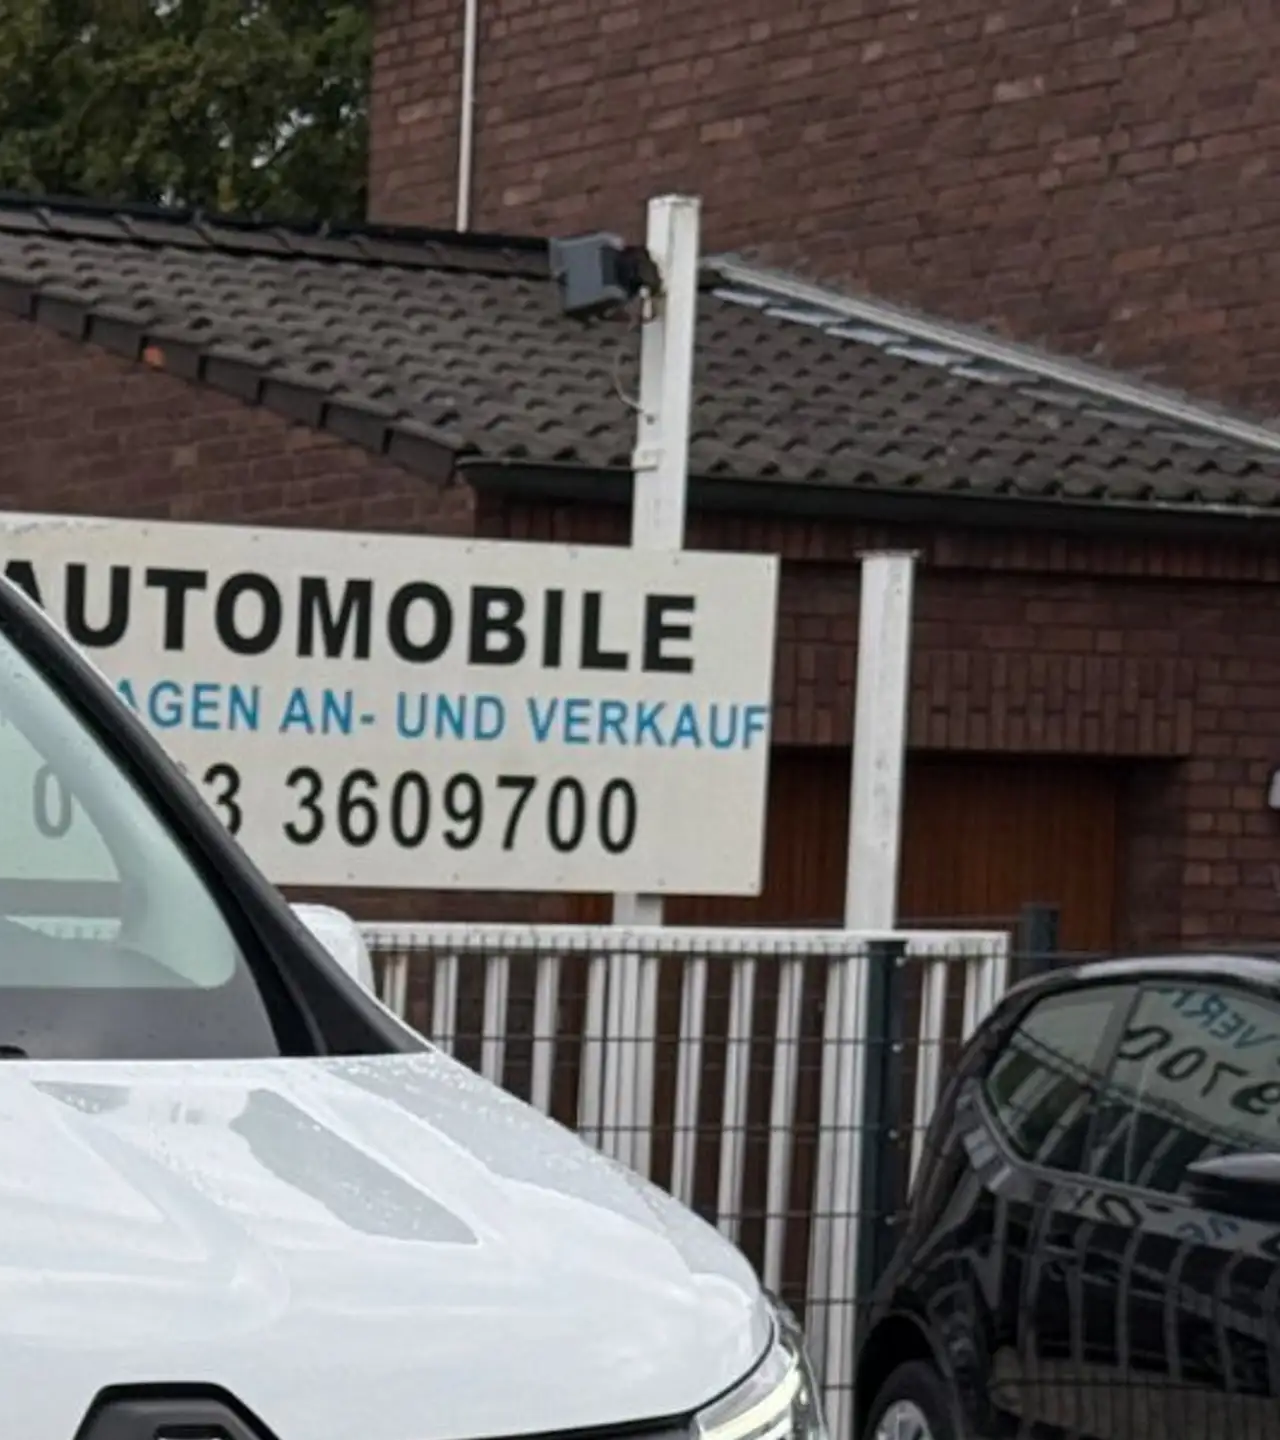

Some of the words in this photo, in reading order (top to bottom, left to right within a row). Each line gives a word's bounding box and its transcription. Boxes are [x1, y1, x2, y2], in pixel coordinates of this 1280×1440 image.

[278, 687, 375, 736] AN-
[395, 691, 506, 742] UND
[527, 696, 769, 750] VERKAUF
[283, 766, 638, 854] 3609700
